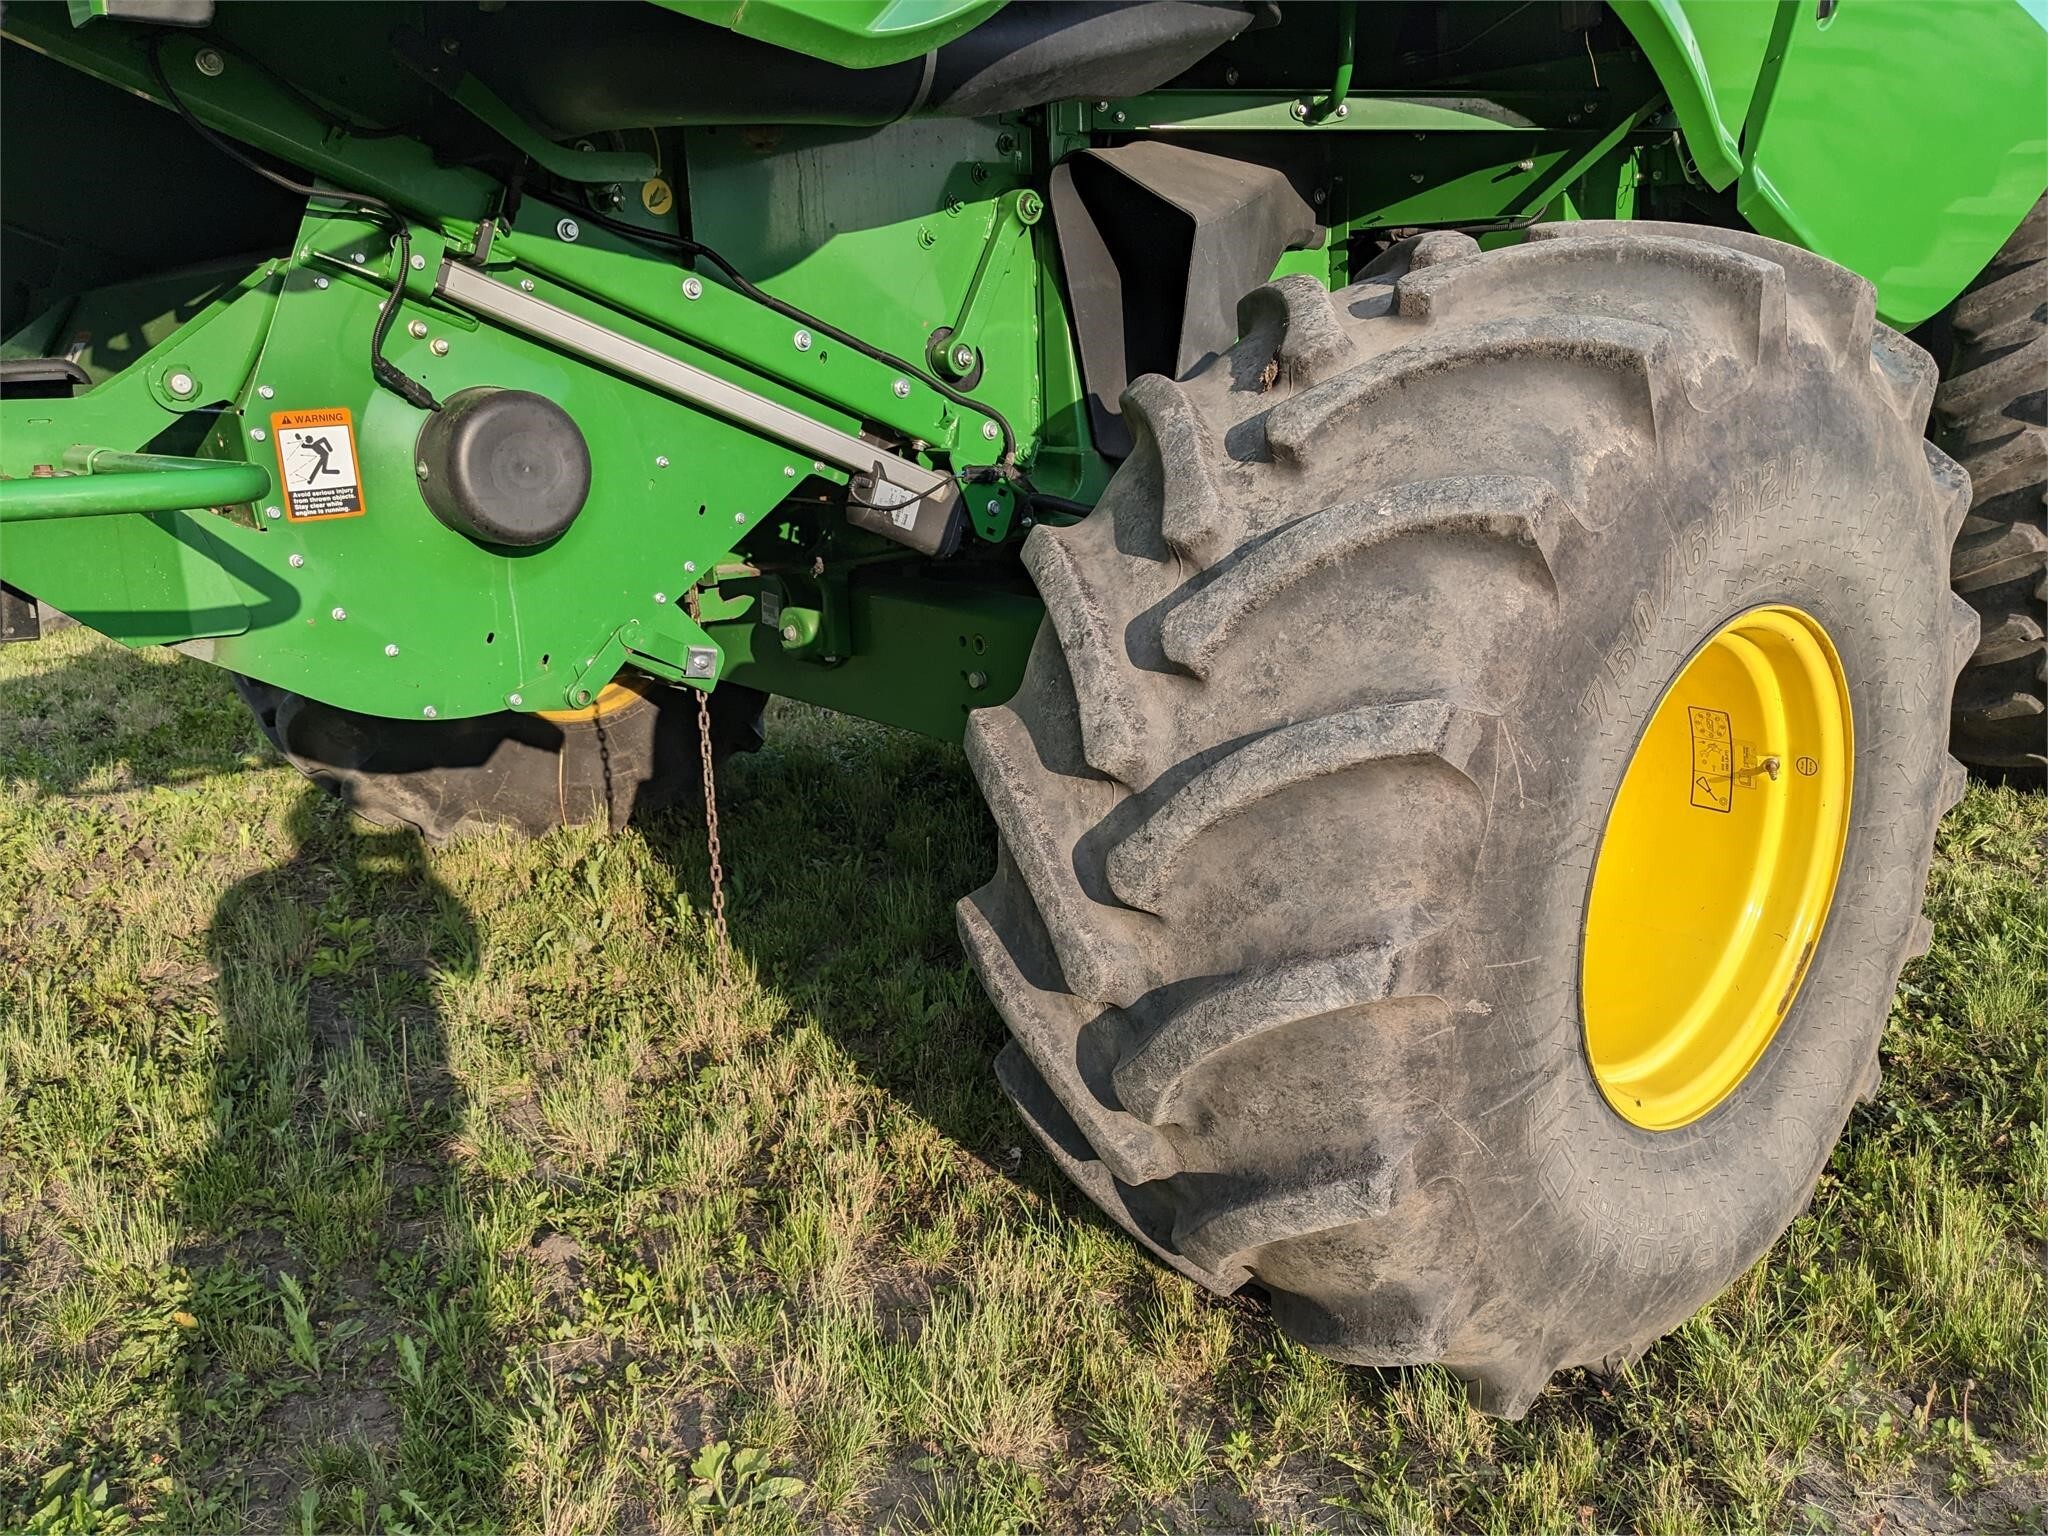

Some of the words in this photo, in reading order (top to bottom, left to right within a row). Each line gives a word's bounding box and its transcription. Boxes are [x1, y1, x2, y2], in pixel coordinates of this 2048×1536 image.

[294, 413, 343, 423] WARNING
[1673, 1205, 1708, 1236] ALL
[1576, 1199, 1716, 1276] RADIAL
